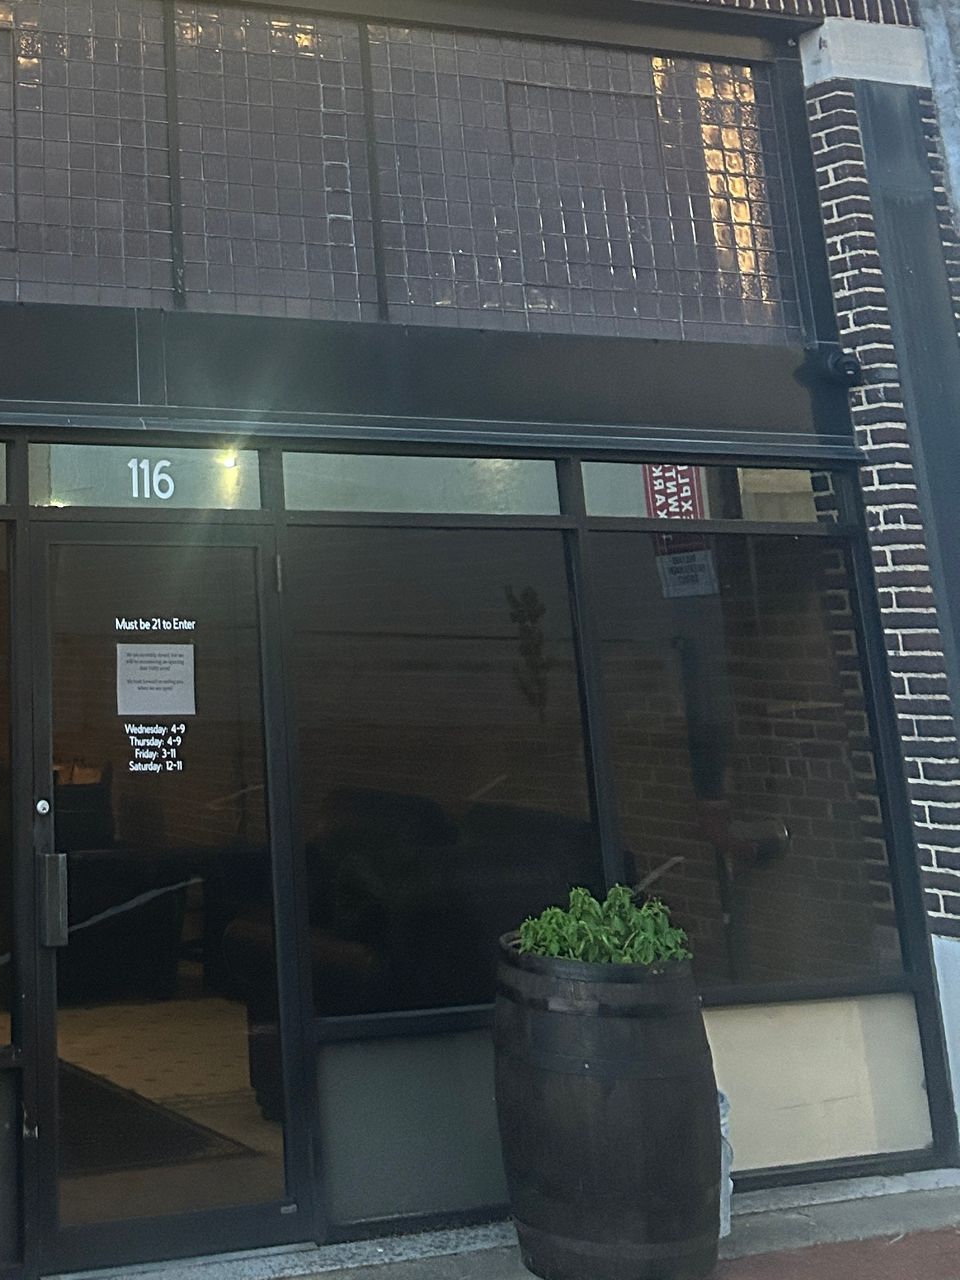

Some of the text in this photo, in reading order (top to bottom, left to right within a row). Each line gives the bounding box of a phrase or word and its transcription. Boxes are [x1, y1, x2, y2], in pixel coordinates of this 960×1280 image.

[127, 458, 175, 499] 116
[115, 618, 196, 630] Must be 21 to Enter
[171, 723, 186, 734] 4-9
[167, 736, 182, 746] 4-9
[161, 748, 177, 758] 3-11
[165, 760, 183, 771] 12-11
